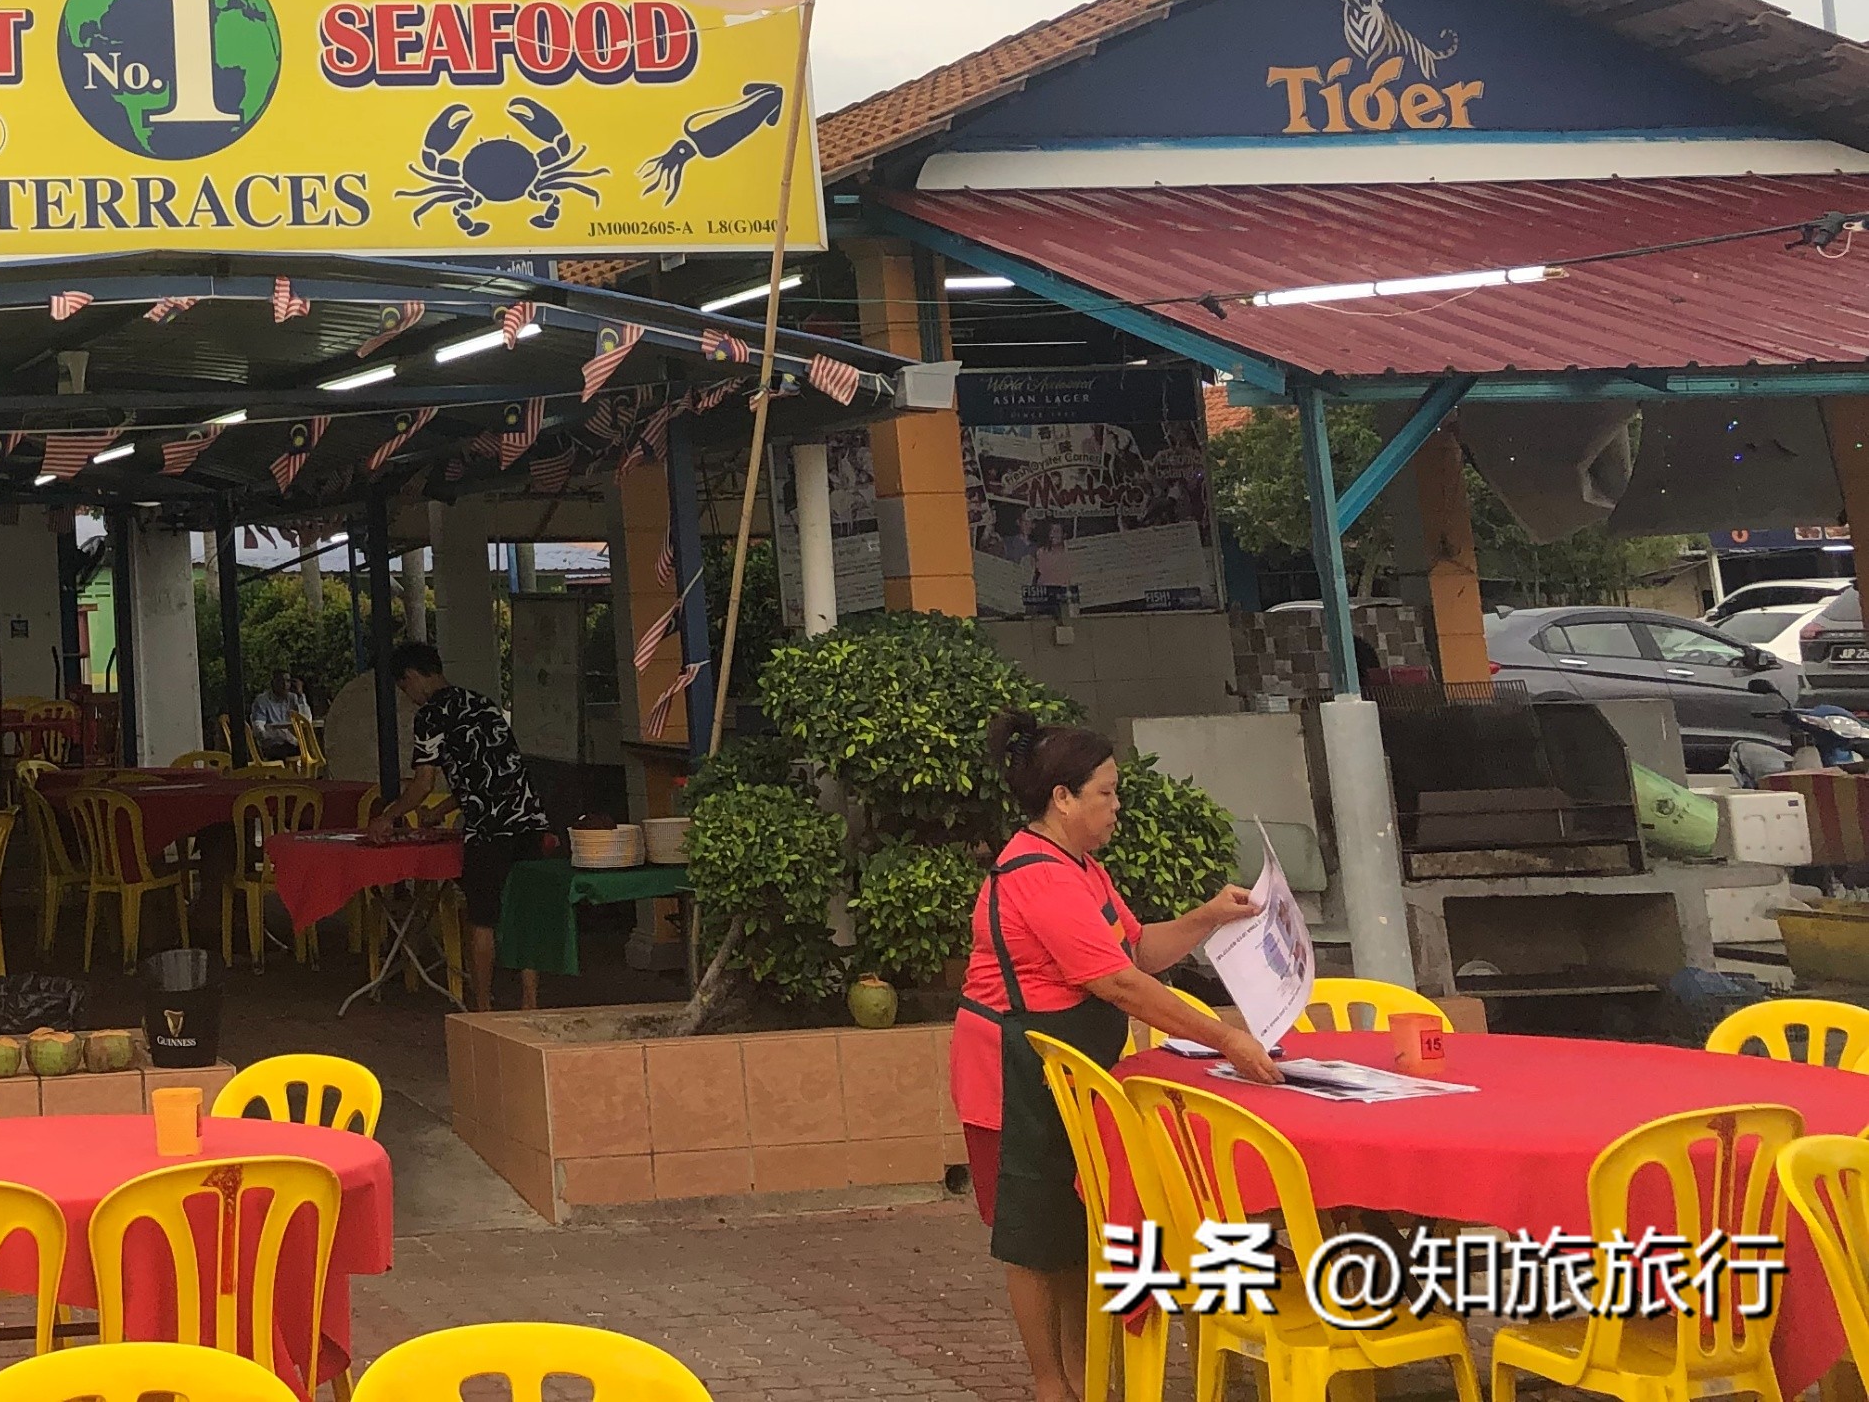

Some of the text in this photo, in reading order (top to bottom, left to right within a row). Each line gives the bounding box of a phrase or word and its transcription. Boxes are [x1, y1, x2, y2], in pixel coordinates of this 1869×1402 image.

[318, 0, 699, 89] SEAFOOD
[83, 51, 164, 90] No.
[1266, 56, 1485, 134] Tiger
[587, 218, 789, 238] JM0002605-A L8(G)040
[993, 393, 1091, 406] ASIAN LAGER
[156, 1035, 197, 1047] GUINNESS
[1424, 1038, 1442, 1052] 15
